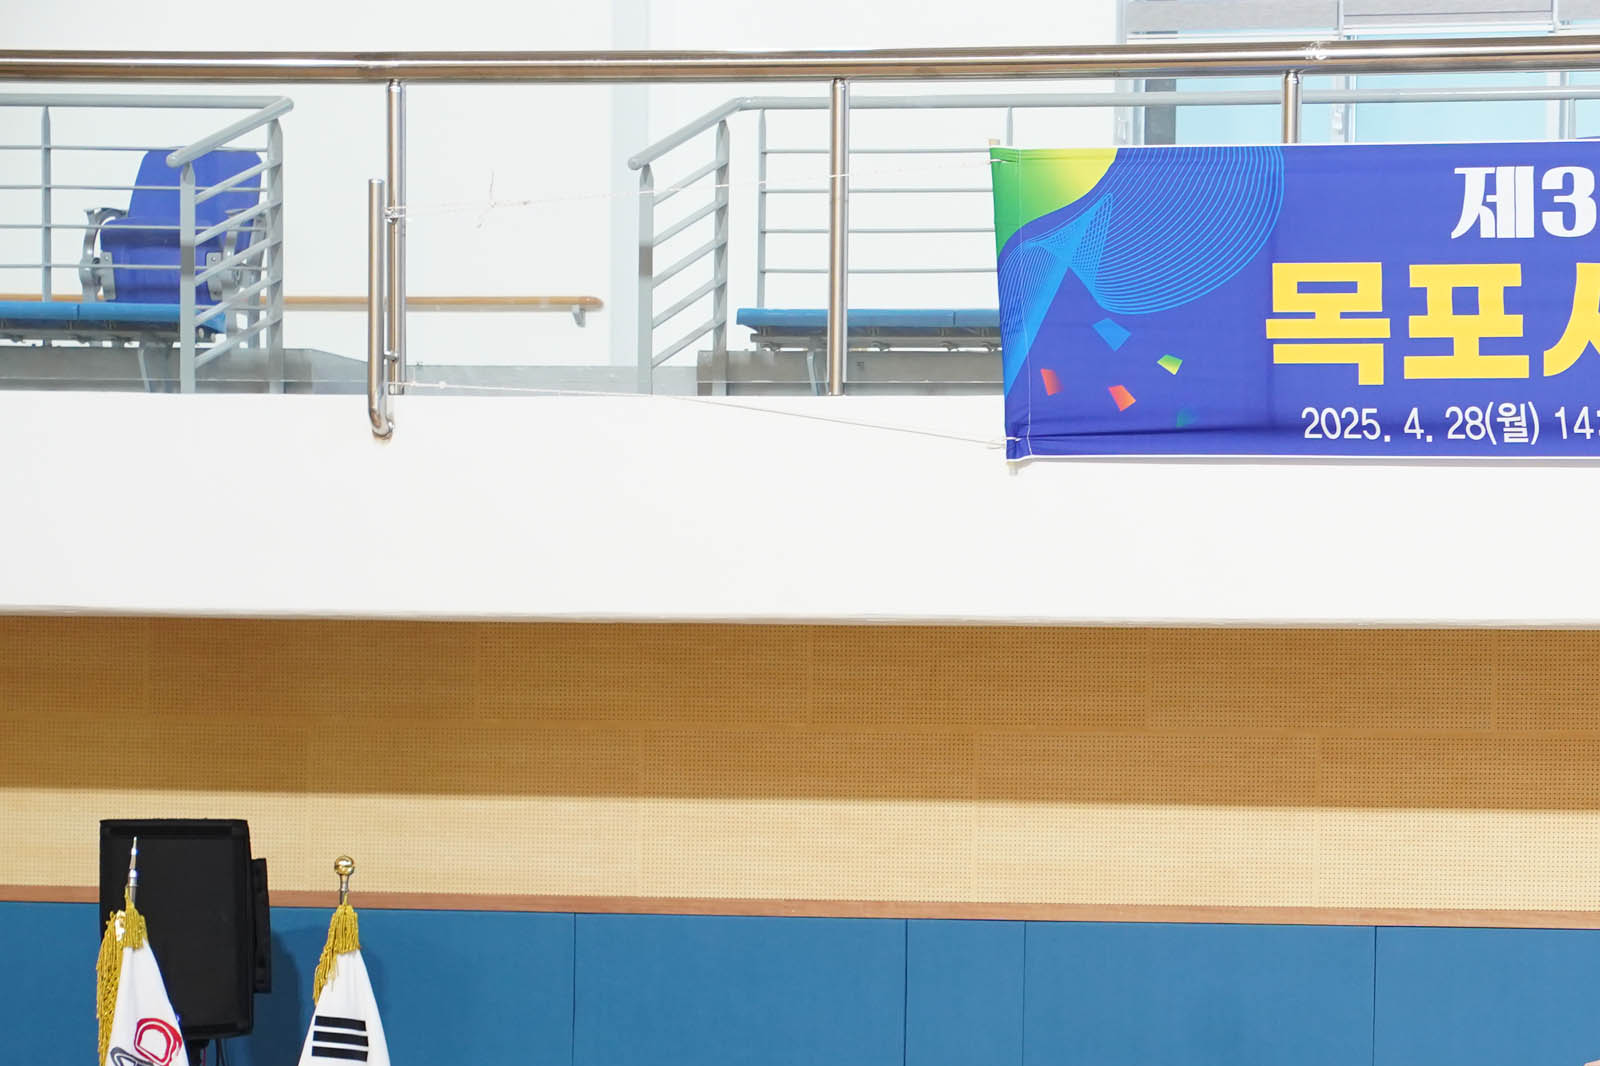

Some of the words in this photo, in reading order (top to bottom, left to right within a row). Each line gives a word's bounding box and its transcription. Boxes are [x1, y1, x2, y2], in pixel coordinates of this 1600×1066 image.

[1301, 406, 1391, 443] 2025.
[1403, 407, 1433, 443] 4.
[1445, 401, 1540, 446] 28(월)
